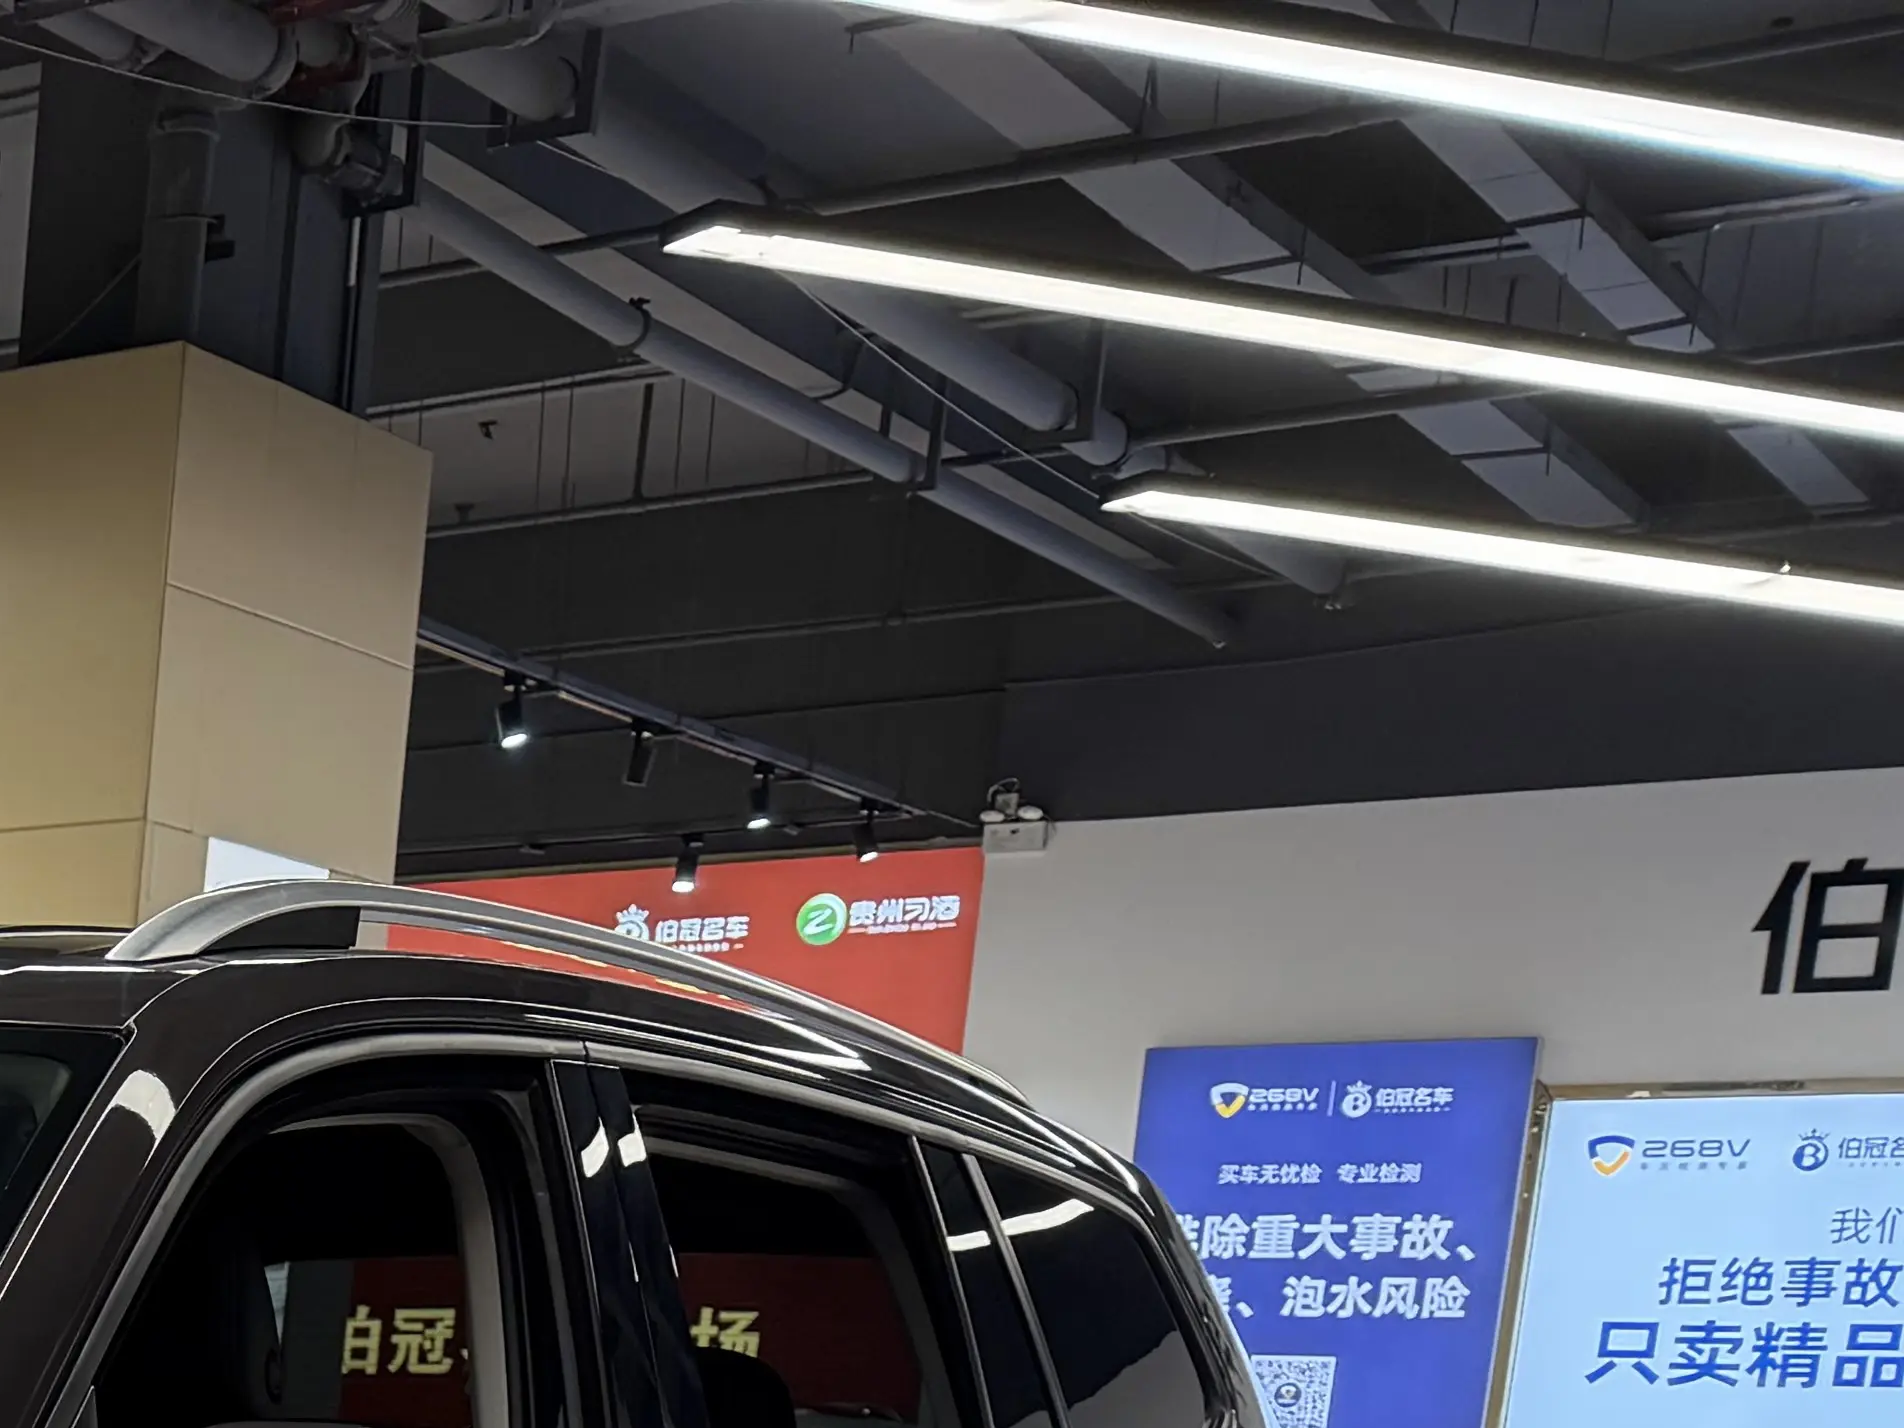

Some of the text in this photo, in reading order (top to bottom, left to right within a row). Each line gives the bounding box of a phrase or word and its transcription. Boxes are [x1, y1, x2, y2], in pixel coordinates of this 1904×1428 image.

[1751, 857, 1904, 995] 伯
[1337, 1162, 1423, 1184] 专业检测
[1642, 1138, 1751, 1157] 268V
[1658, 1256, 1904, 1308] 拒绝事故
[1584, 1320, 1904, 1389] 只卖精品
